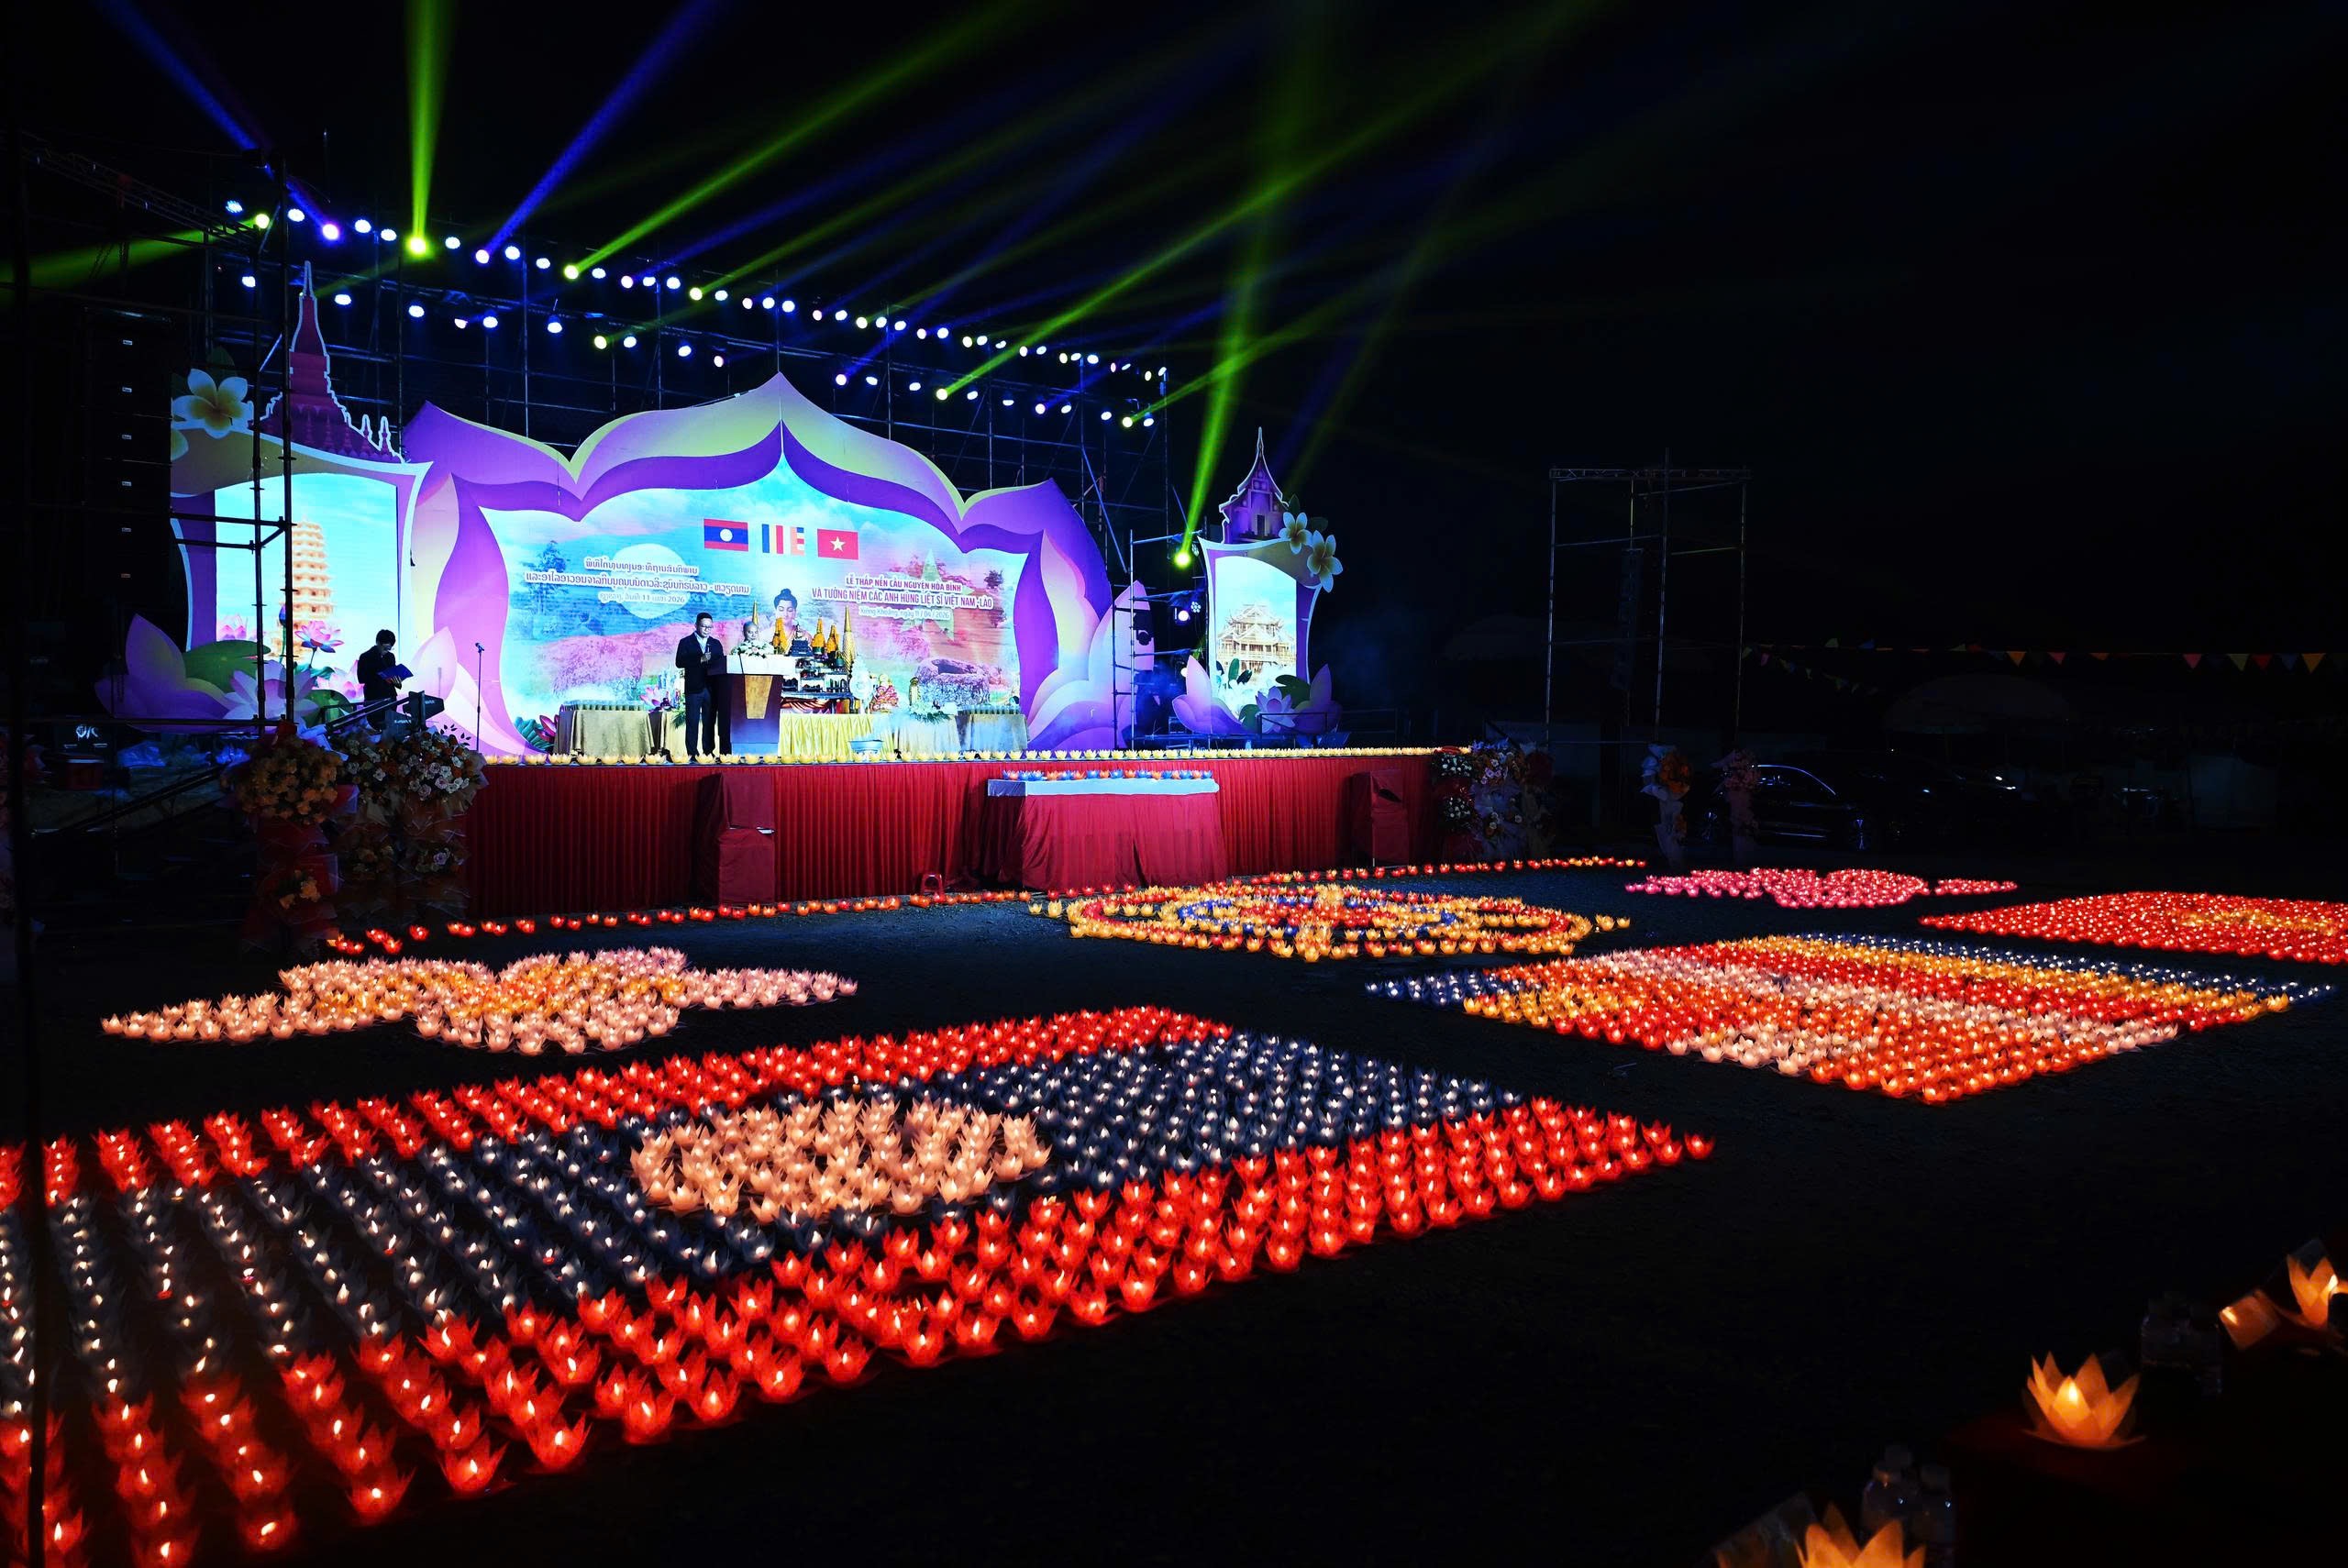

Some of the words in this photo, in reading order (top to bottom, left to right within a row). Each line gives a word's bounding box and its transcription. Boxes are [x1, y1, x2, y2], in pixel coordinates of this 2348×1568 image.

[847, 574, 853, 585] LỄ
[875, 576, 888, 587] NẾN
[890, 577, 903, 588] CẦU
[903, 580, 929, 591] NGUYỆN
[931, 581, 945, 591] HÒA
[946, 582, 961, 591] BÌNH
[668, 595, 685, 603] 2026
[812, 586, 822, 598] VÀ
[824, 587, 847, 600] TƯỞNG
[849, 589, 868, 602] NIỆM
[869, 590, 883, 602] CÁC
[884, 591, 899, 602] ANH
[901, 591, 919, 603] HÙNG
[921, 592, 935, 606] LIỆT
[944, 594, 958, 606] VIỆT
[960, 596, 976, 606] NAM
